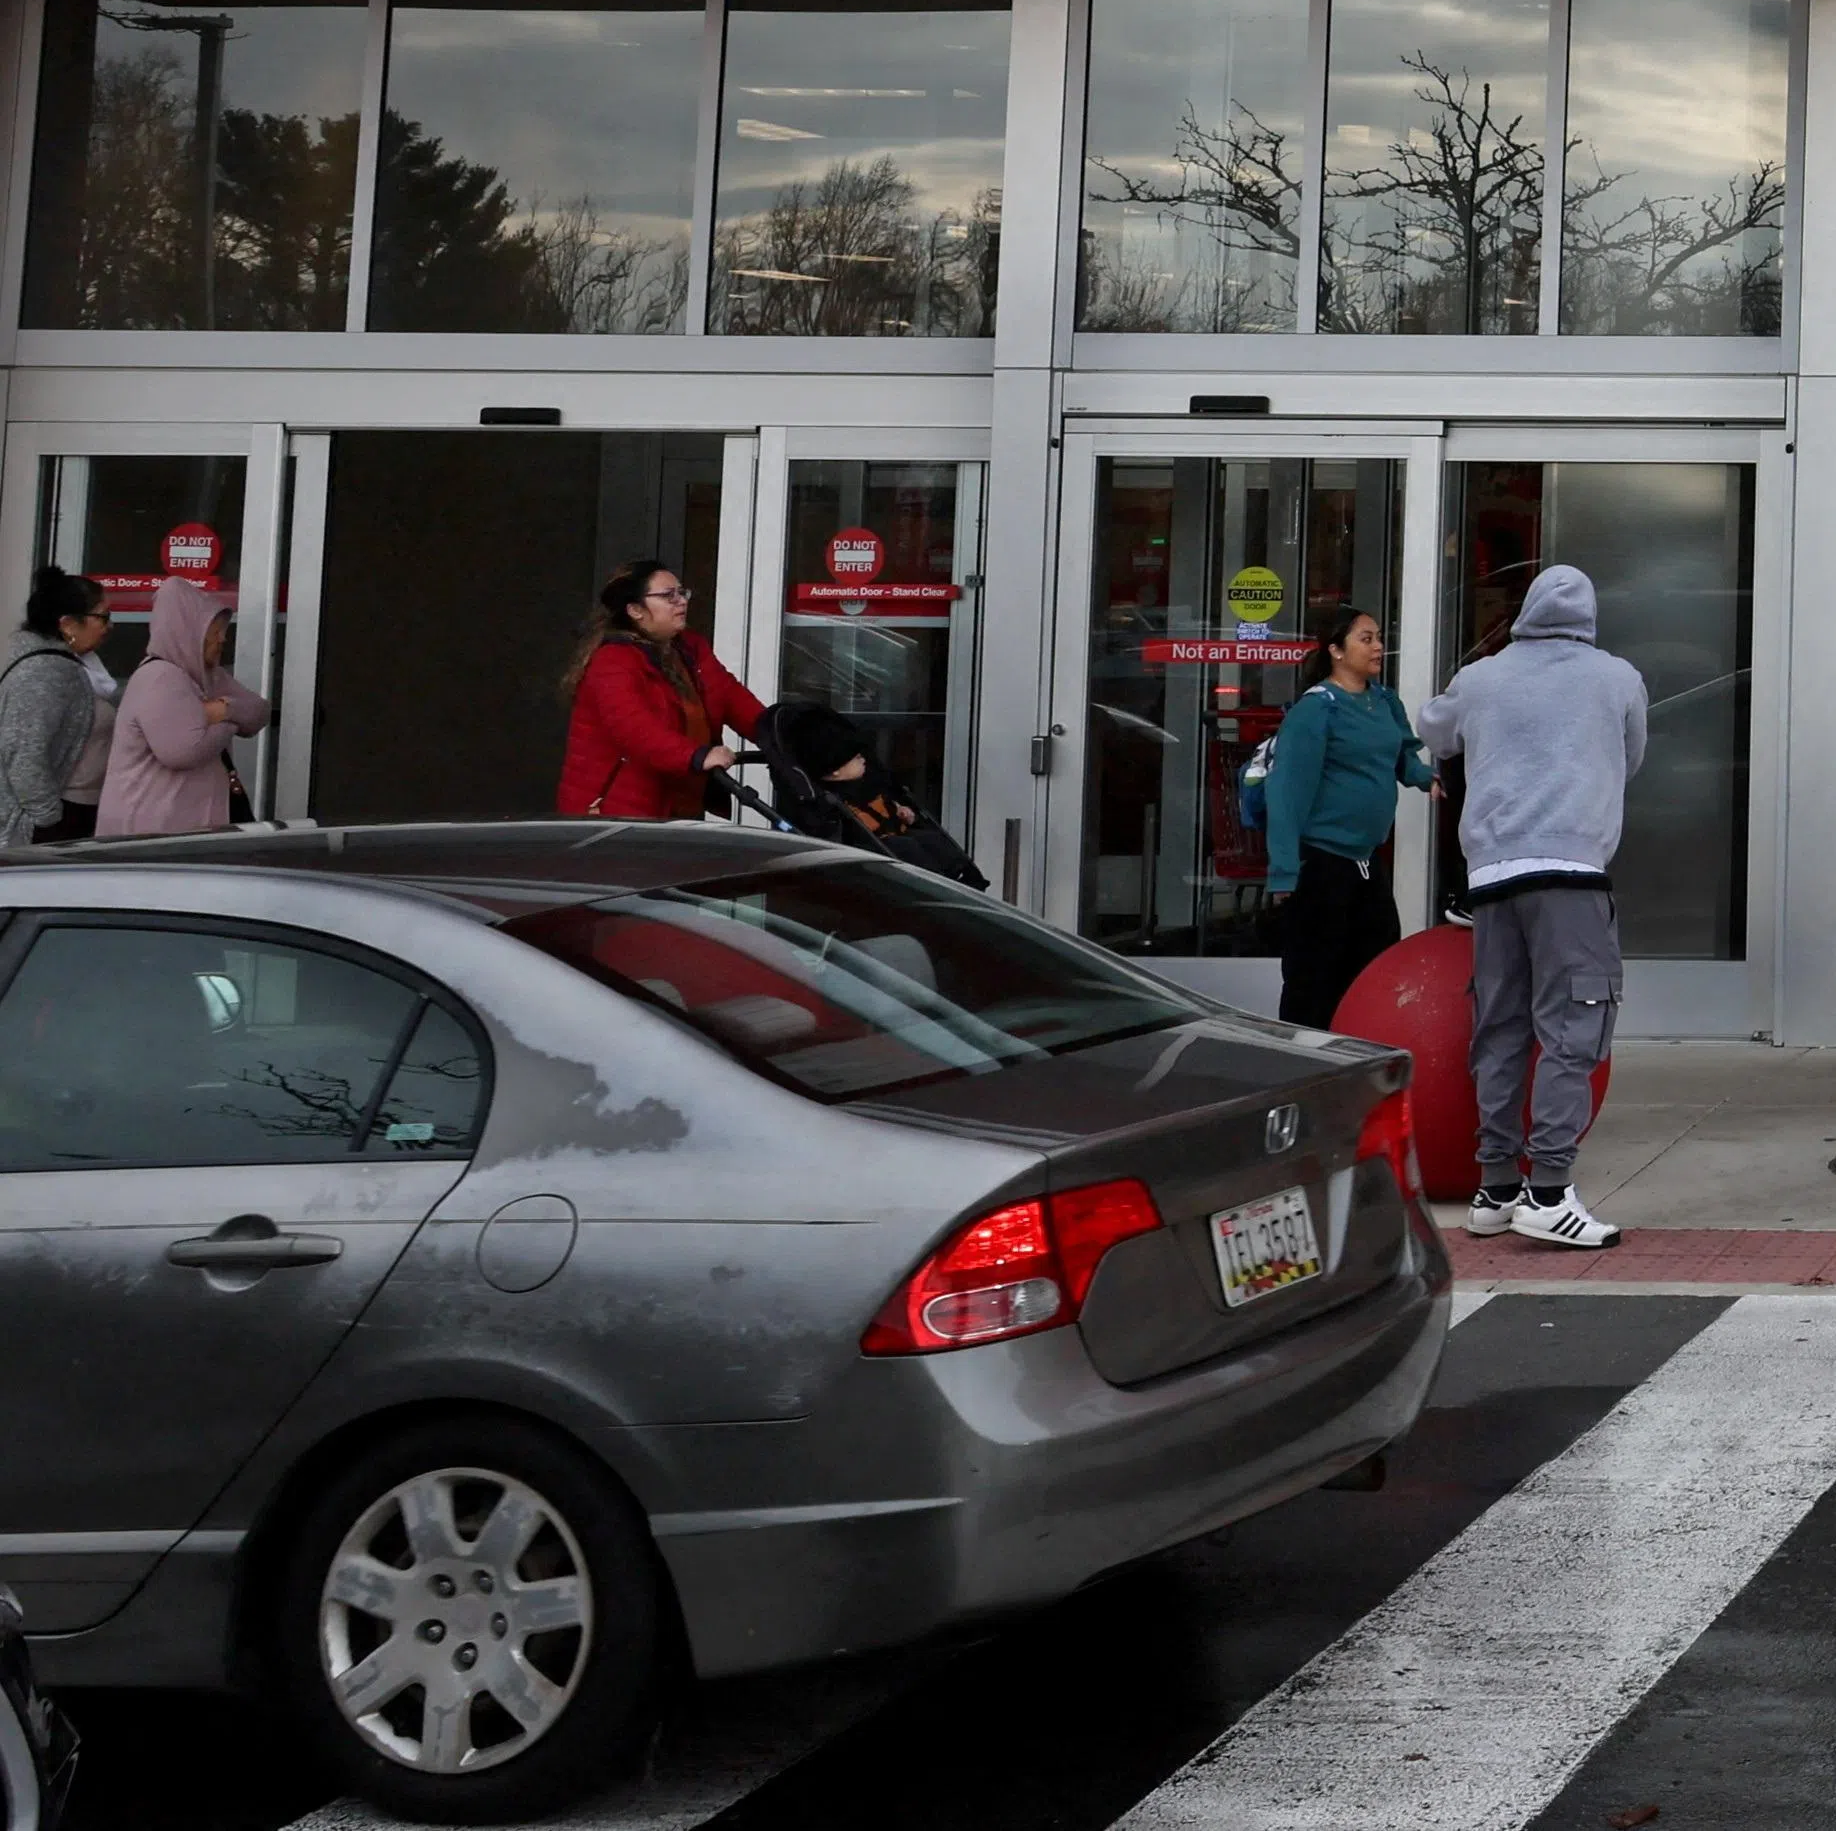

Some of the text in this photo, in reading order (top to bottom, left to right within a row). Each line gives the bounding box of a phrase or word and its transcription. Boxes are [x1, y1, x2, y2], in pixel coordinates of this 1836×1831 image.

[169, 536, 213, 546] DO NOT
[833, 540, 876, 550] DO NOT
[169, 558, 209, 568] ENTER
[834, 562, 873, 572] ENTER
[117, 578, 142, 587] Door
[810, 586, 858, 596] Automatic
[860, 587, 883, 596] Door
[891, 586, 919, 596] Stand
[921, 587, 946, 597] Clear
[1230, 590, 1282, 600] CAUTION
[1172, 643, 1203, 659] Not
[1208, 648, 1230, 659] an
